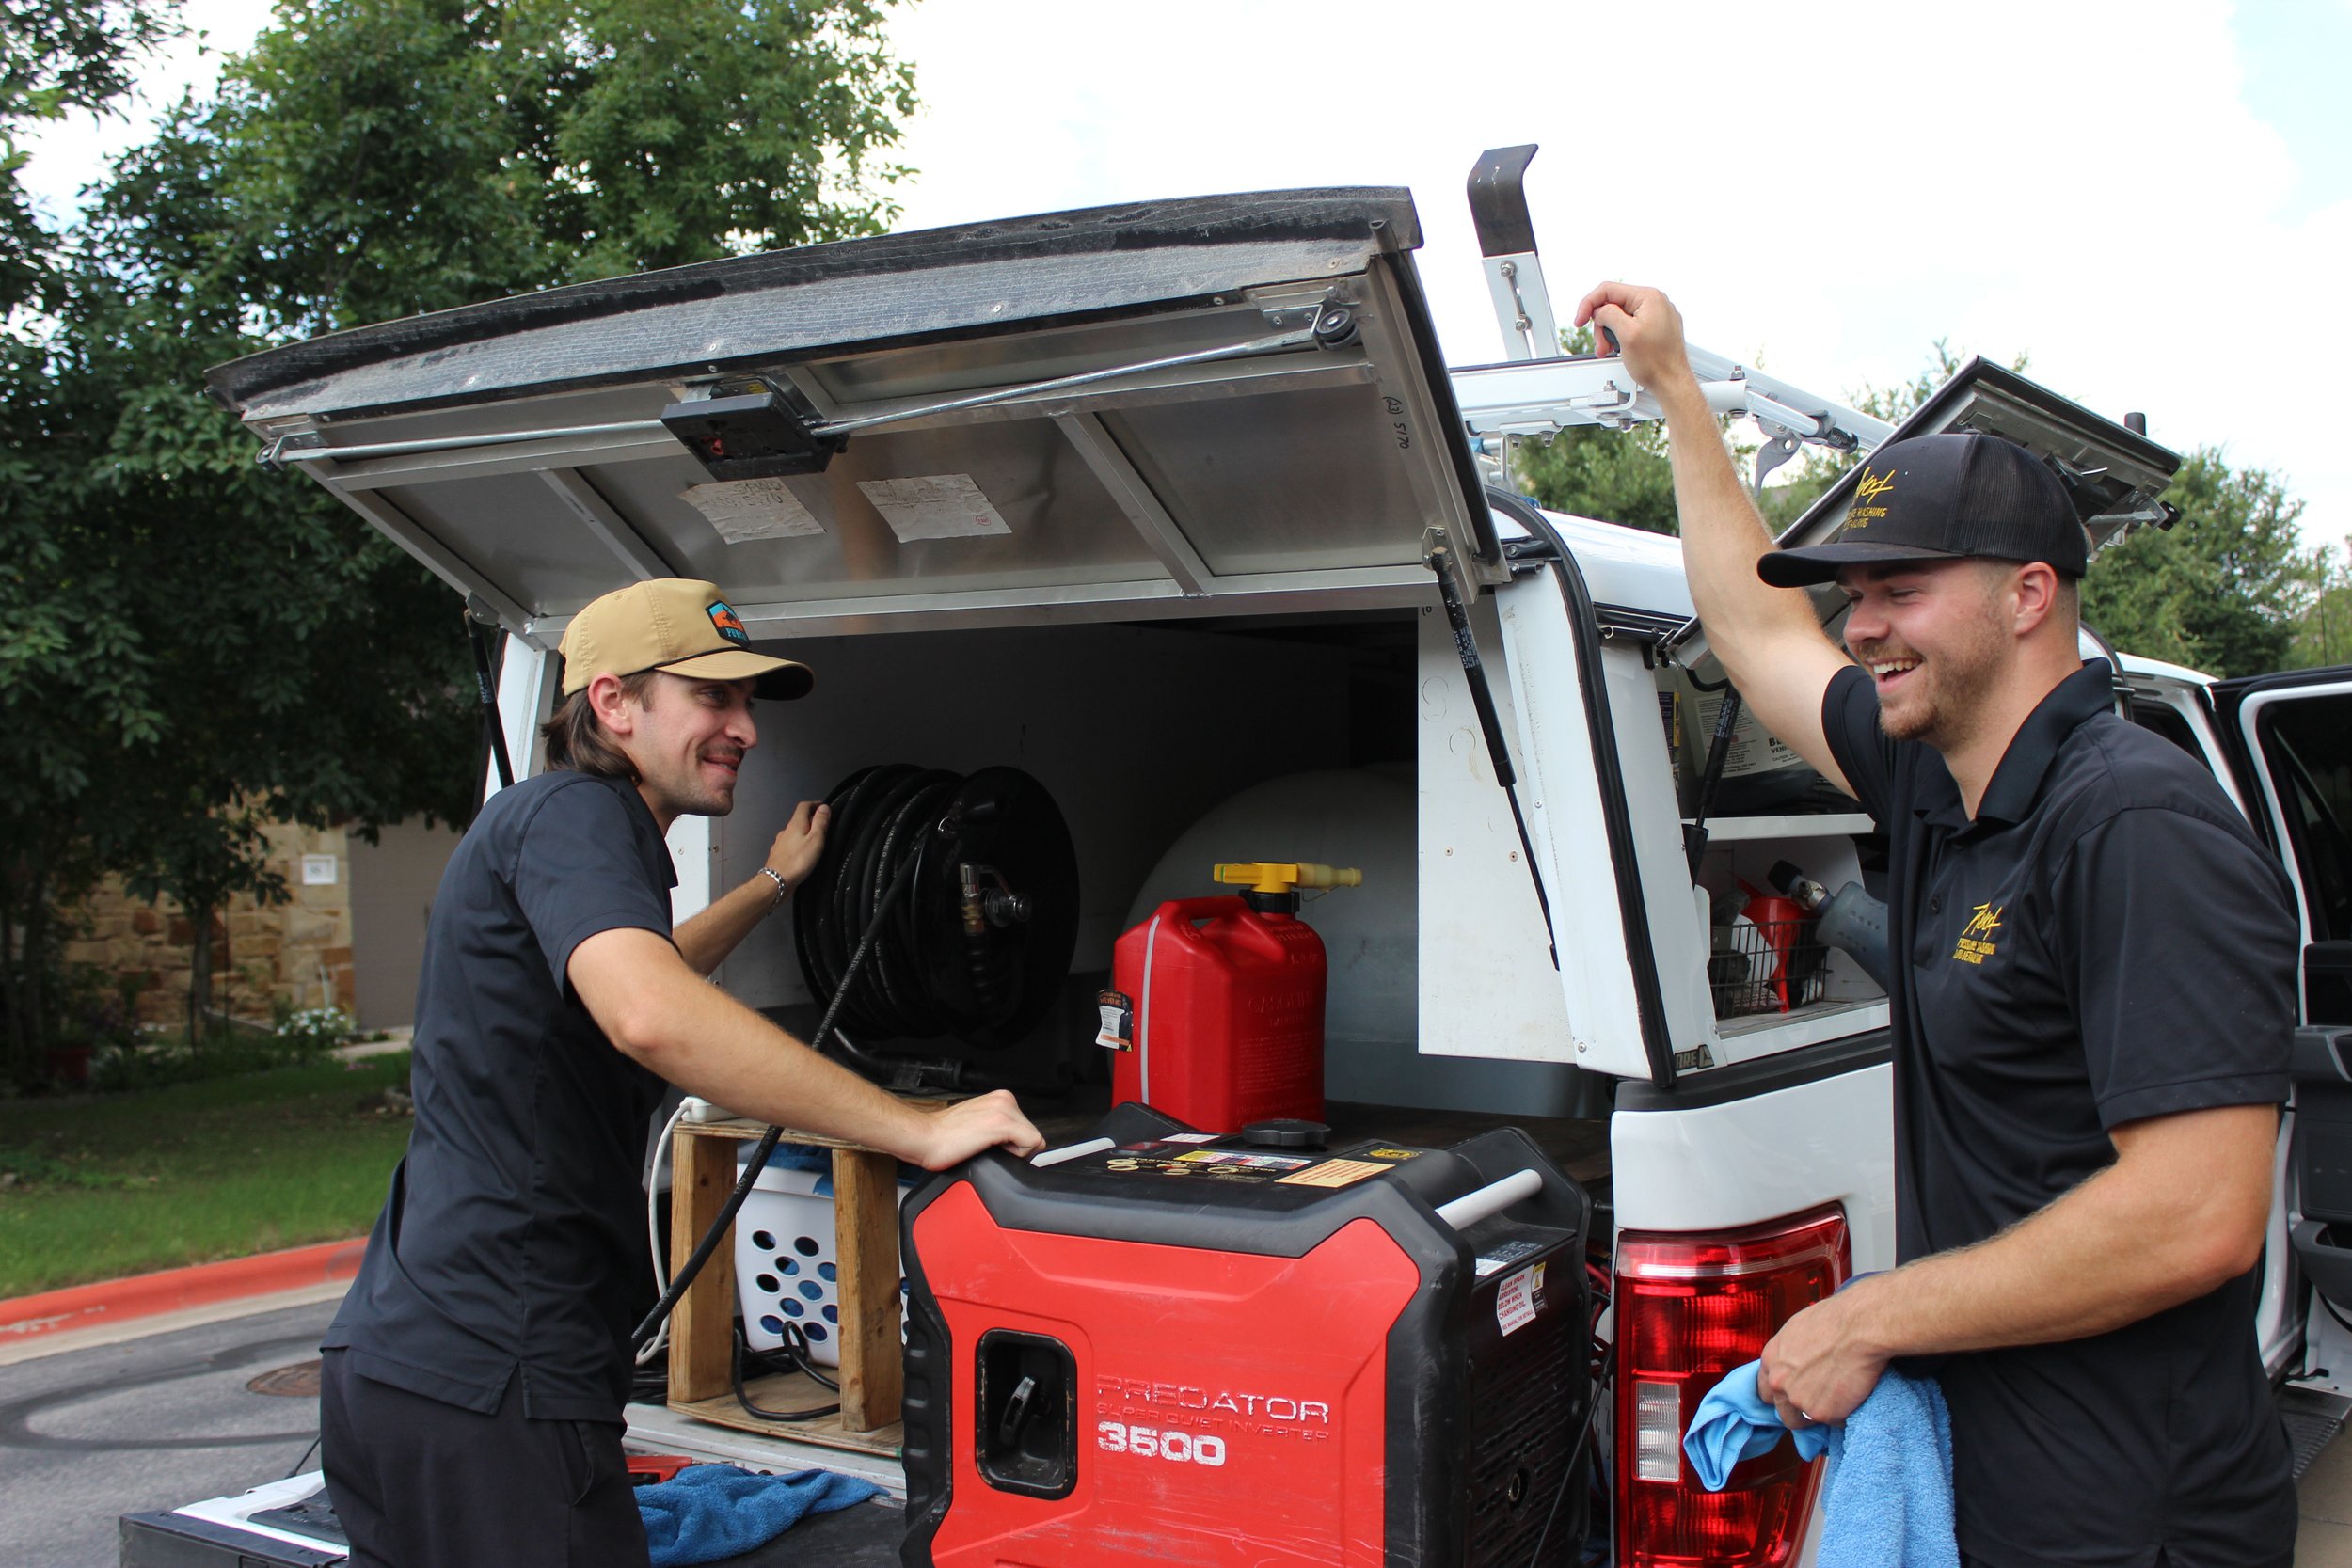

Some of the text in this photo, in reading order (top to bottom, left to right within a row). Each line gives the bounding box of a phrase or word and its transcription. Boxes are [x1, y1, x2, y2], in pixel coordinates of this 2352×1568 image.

[1393, 422, 1410, 450] 5170
[1097, 1374, 1329, 1424] PREDATOR
[1096, 1402, 1330, 1443] SUPER QUIET INVERTER
[1097, 1421, 1227, 1467] 3500
